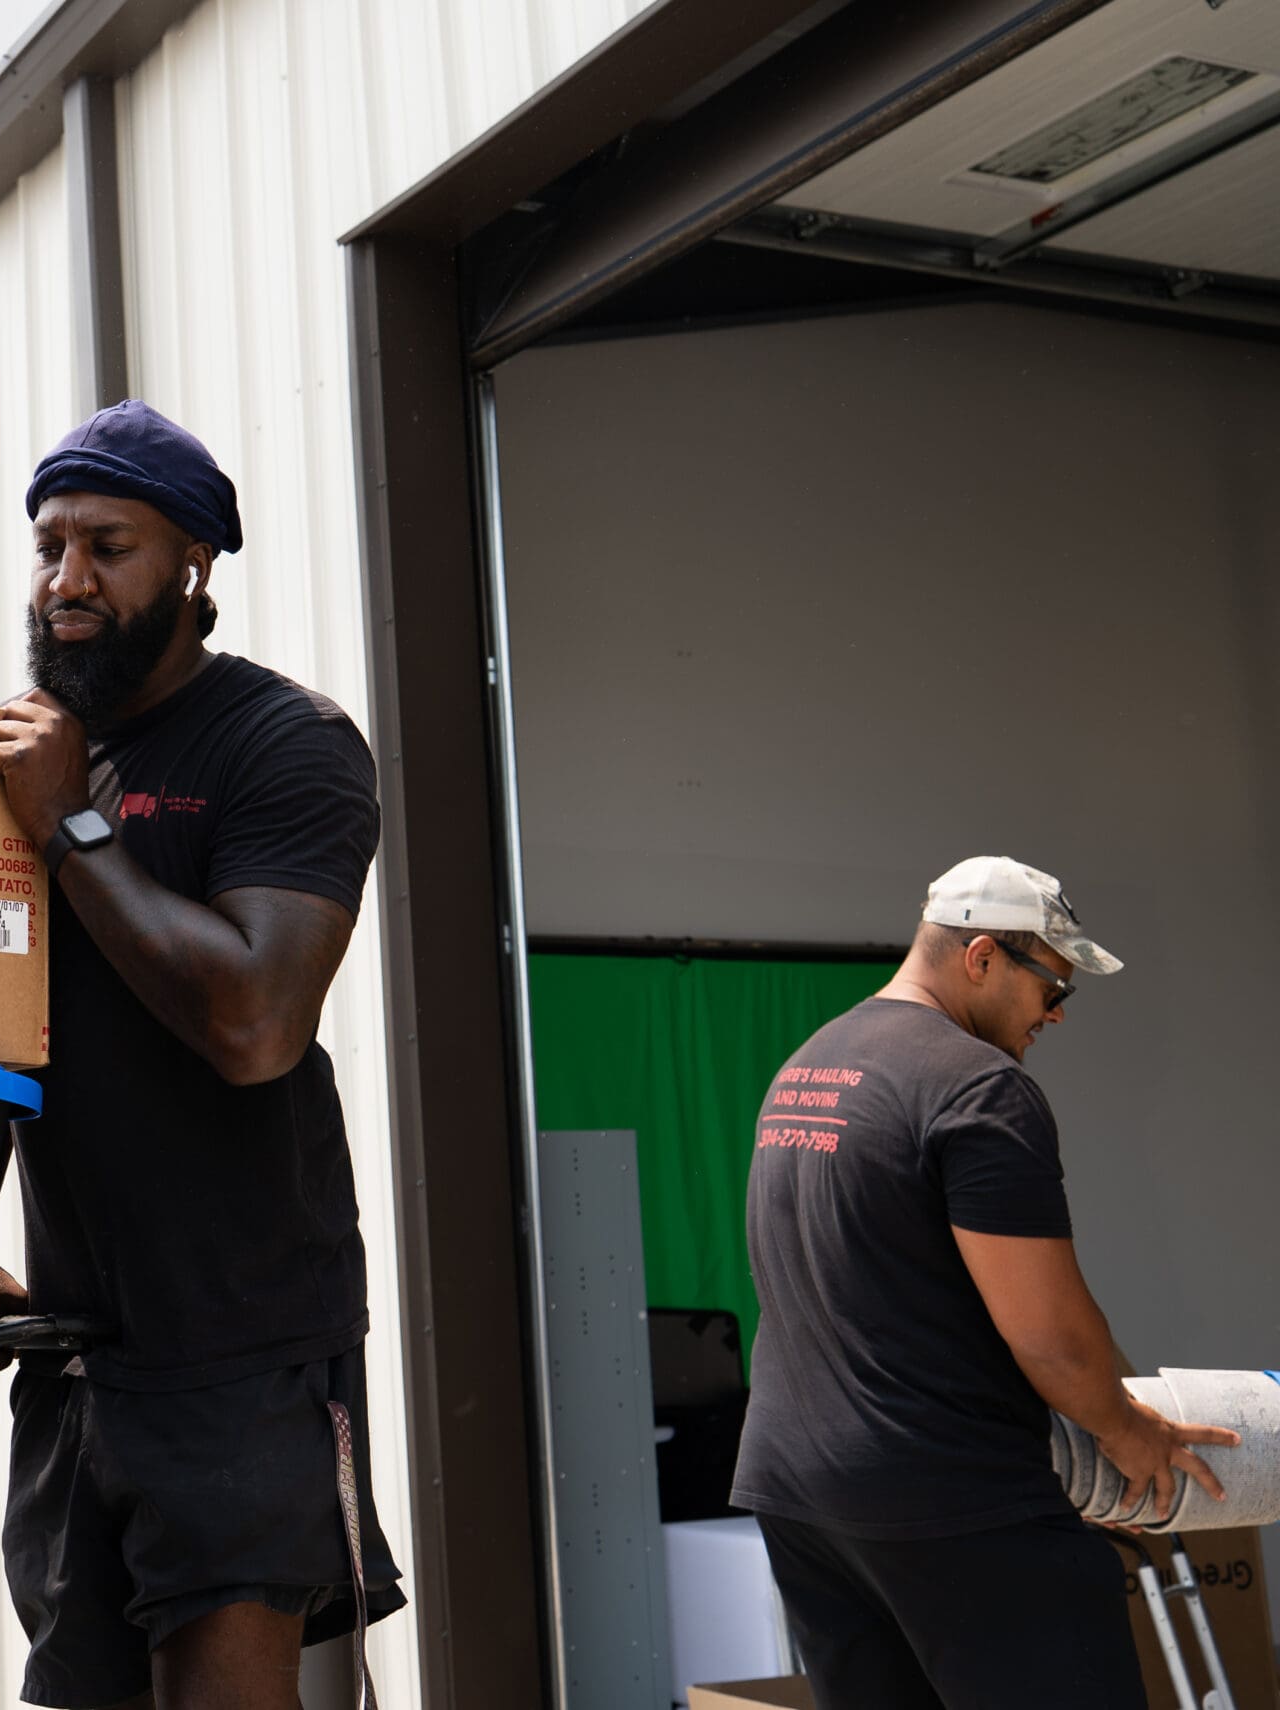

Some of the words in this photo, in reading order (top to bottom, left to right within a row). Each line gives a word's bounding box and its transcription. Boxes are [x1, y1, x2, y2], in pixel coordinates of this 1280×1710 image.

[2, 837, 36, 854] GTIN
[810, 1068, 864, 1086] HAULING
[773, 1089, 797, 1106] AND
[798, 1091, 840, 1108] MOVING
